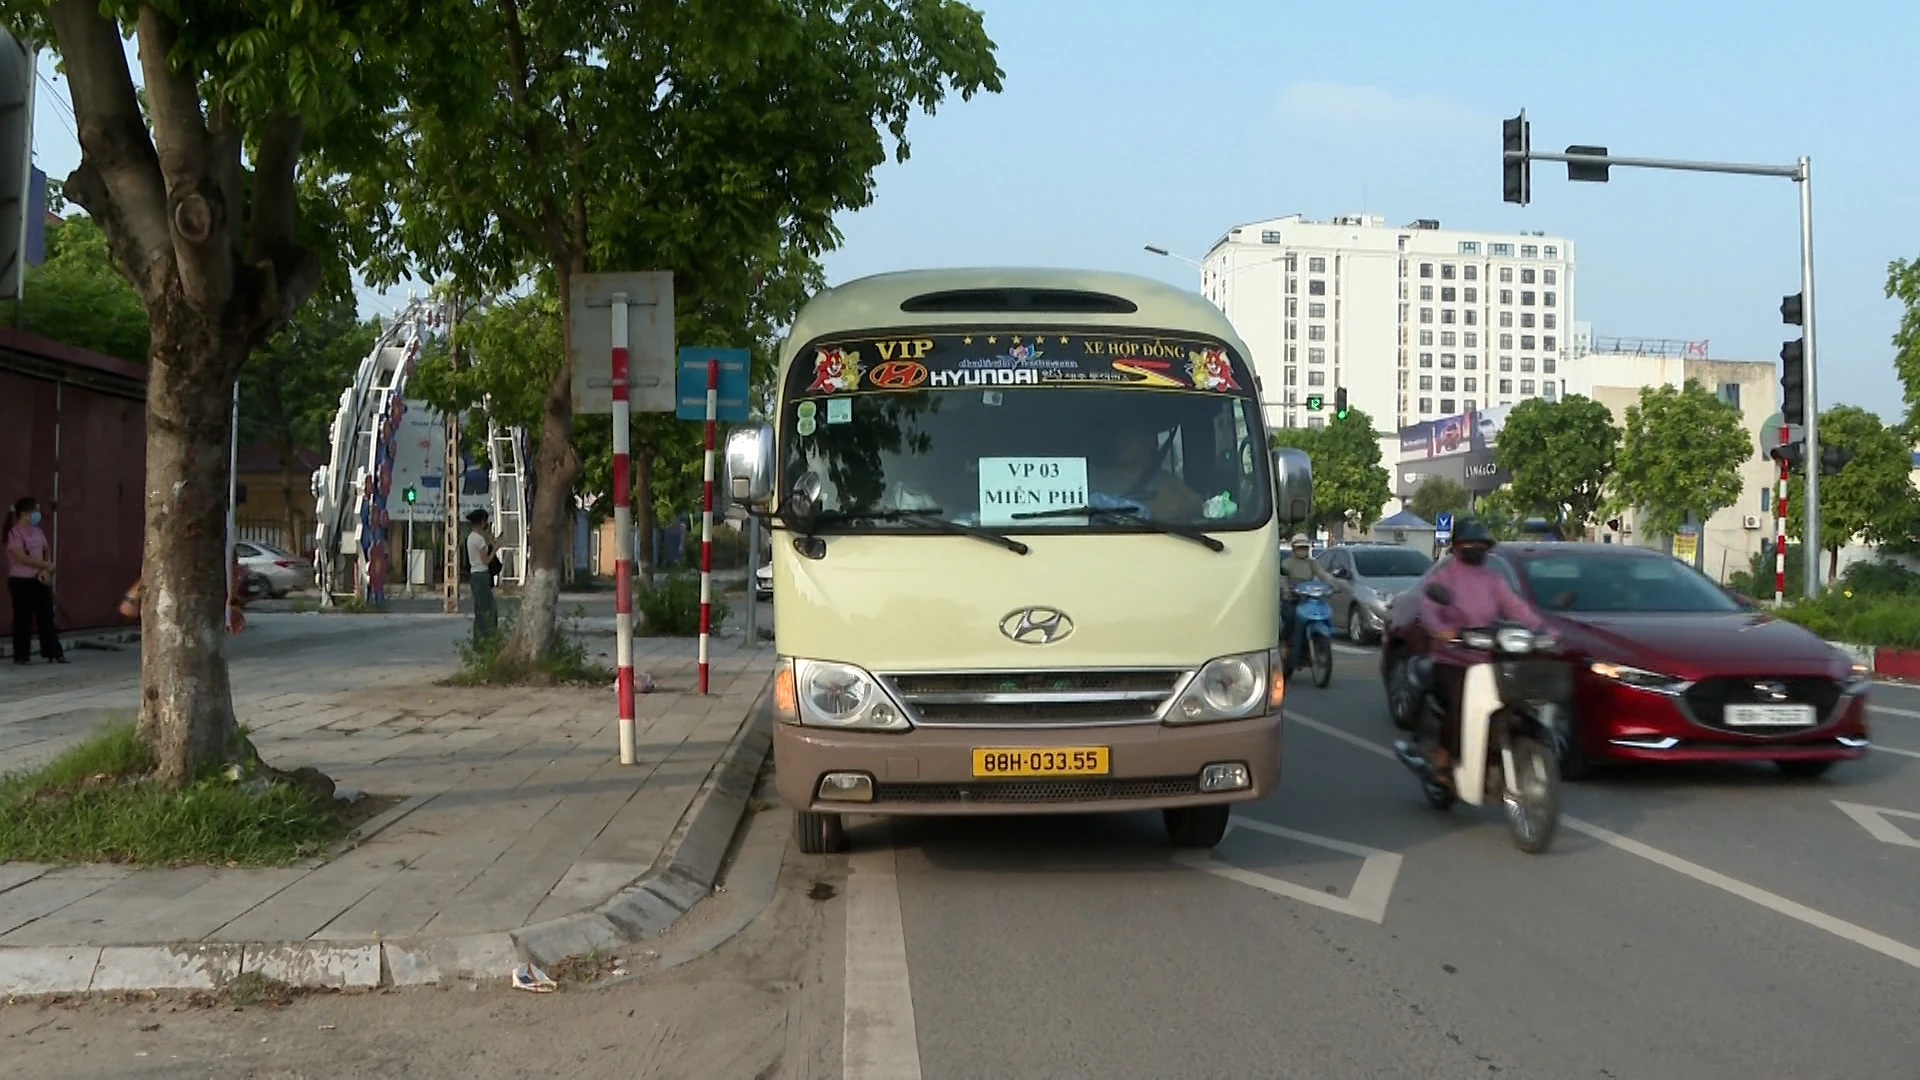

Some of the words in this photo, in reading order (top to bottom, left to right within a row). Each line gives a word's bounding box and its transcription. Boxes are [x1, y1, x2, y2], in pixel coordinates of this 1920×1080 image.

[875, 339, 933, 360] VIP
[1083, 340, 1104, 354] XE
[1108, 342, 1140, 357] HỢP
[930, 369, 1038, 386] HYUNDAI
[1008, 463, 1034, 477] VP
[1040, 463, 1059, 478] 03
[1049, 486, 1084, 504] PHÍ
[984, 751, 1097, 772] 88H-033.55
